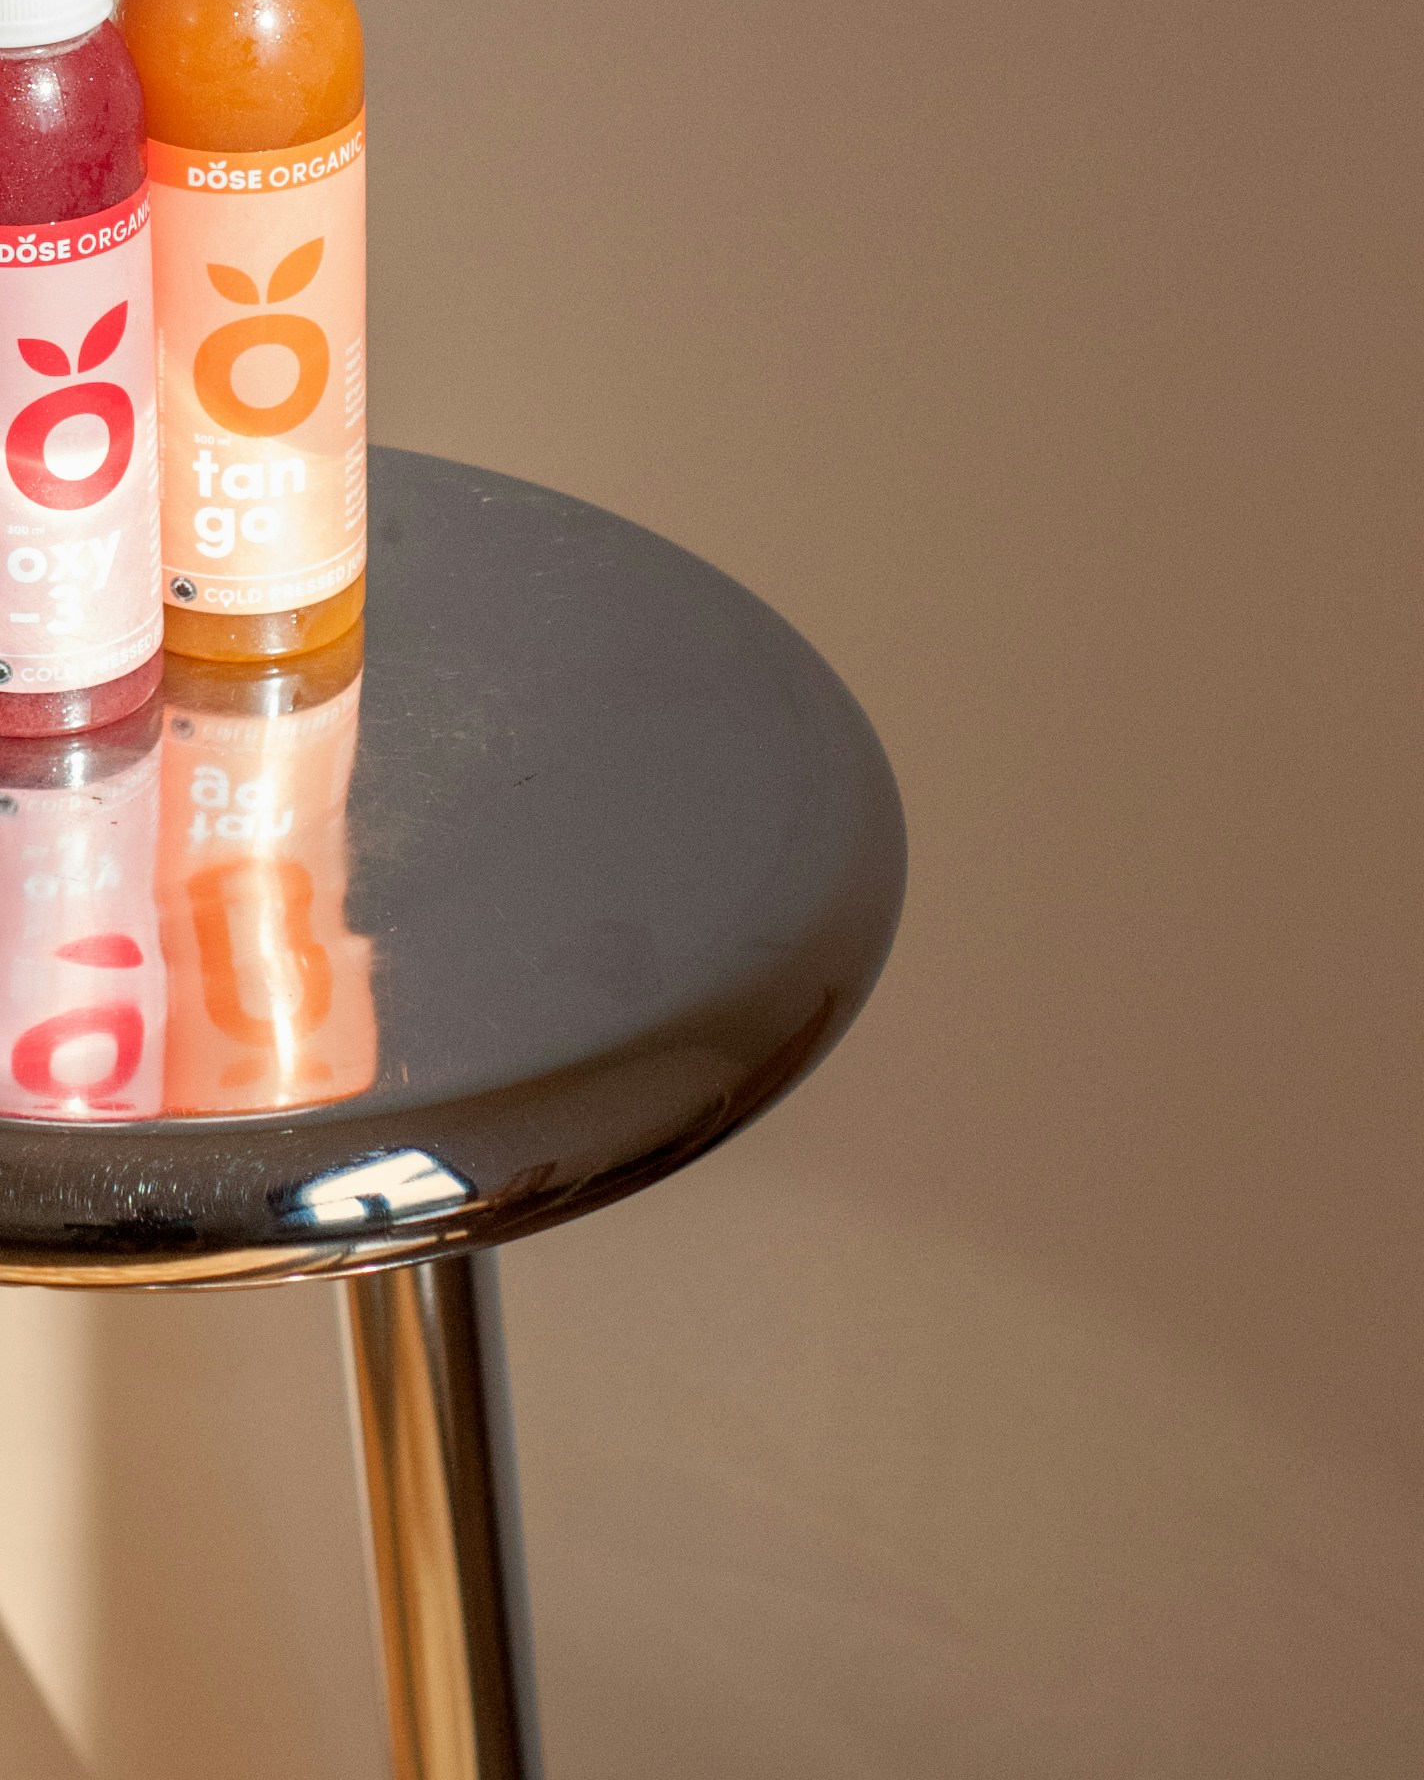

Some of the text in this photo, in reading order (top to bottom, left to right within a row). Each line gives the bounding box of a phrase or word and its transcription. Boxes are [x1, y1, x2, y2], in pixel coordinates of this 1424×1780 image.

[269, 130, 363, 188] ORGANIC
[193, 433, 216, 445] 300
[192, 449, 306, 500] tan
[6, 524, 29, 535] 300
[193, 506, 283, 559] go
[7, 529, 122, 591] oxy
[204, 587, 263, 608] COLD
[269, 564, 346, 603] PRESSED
